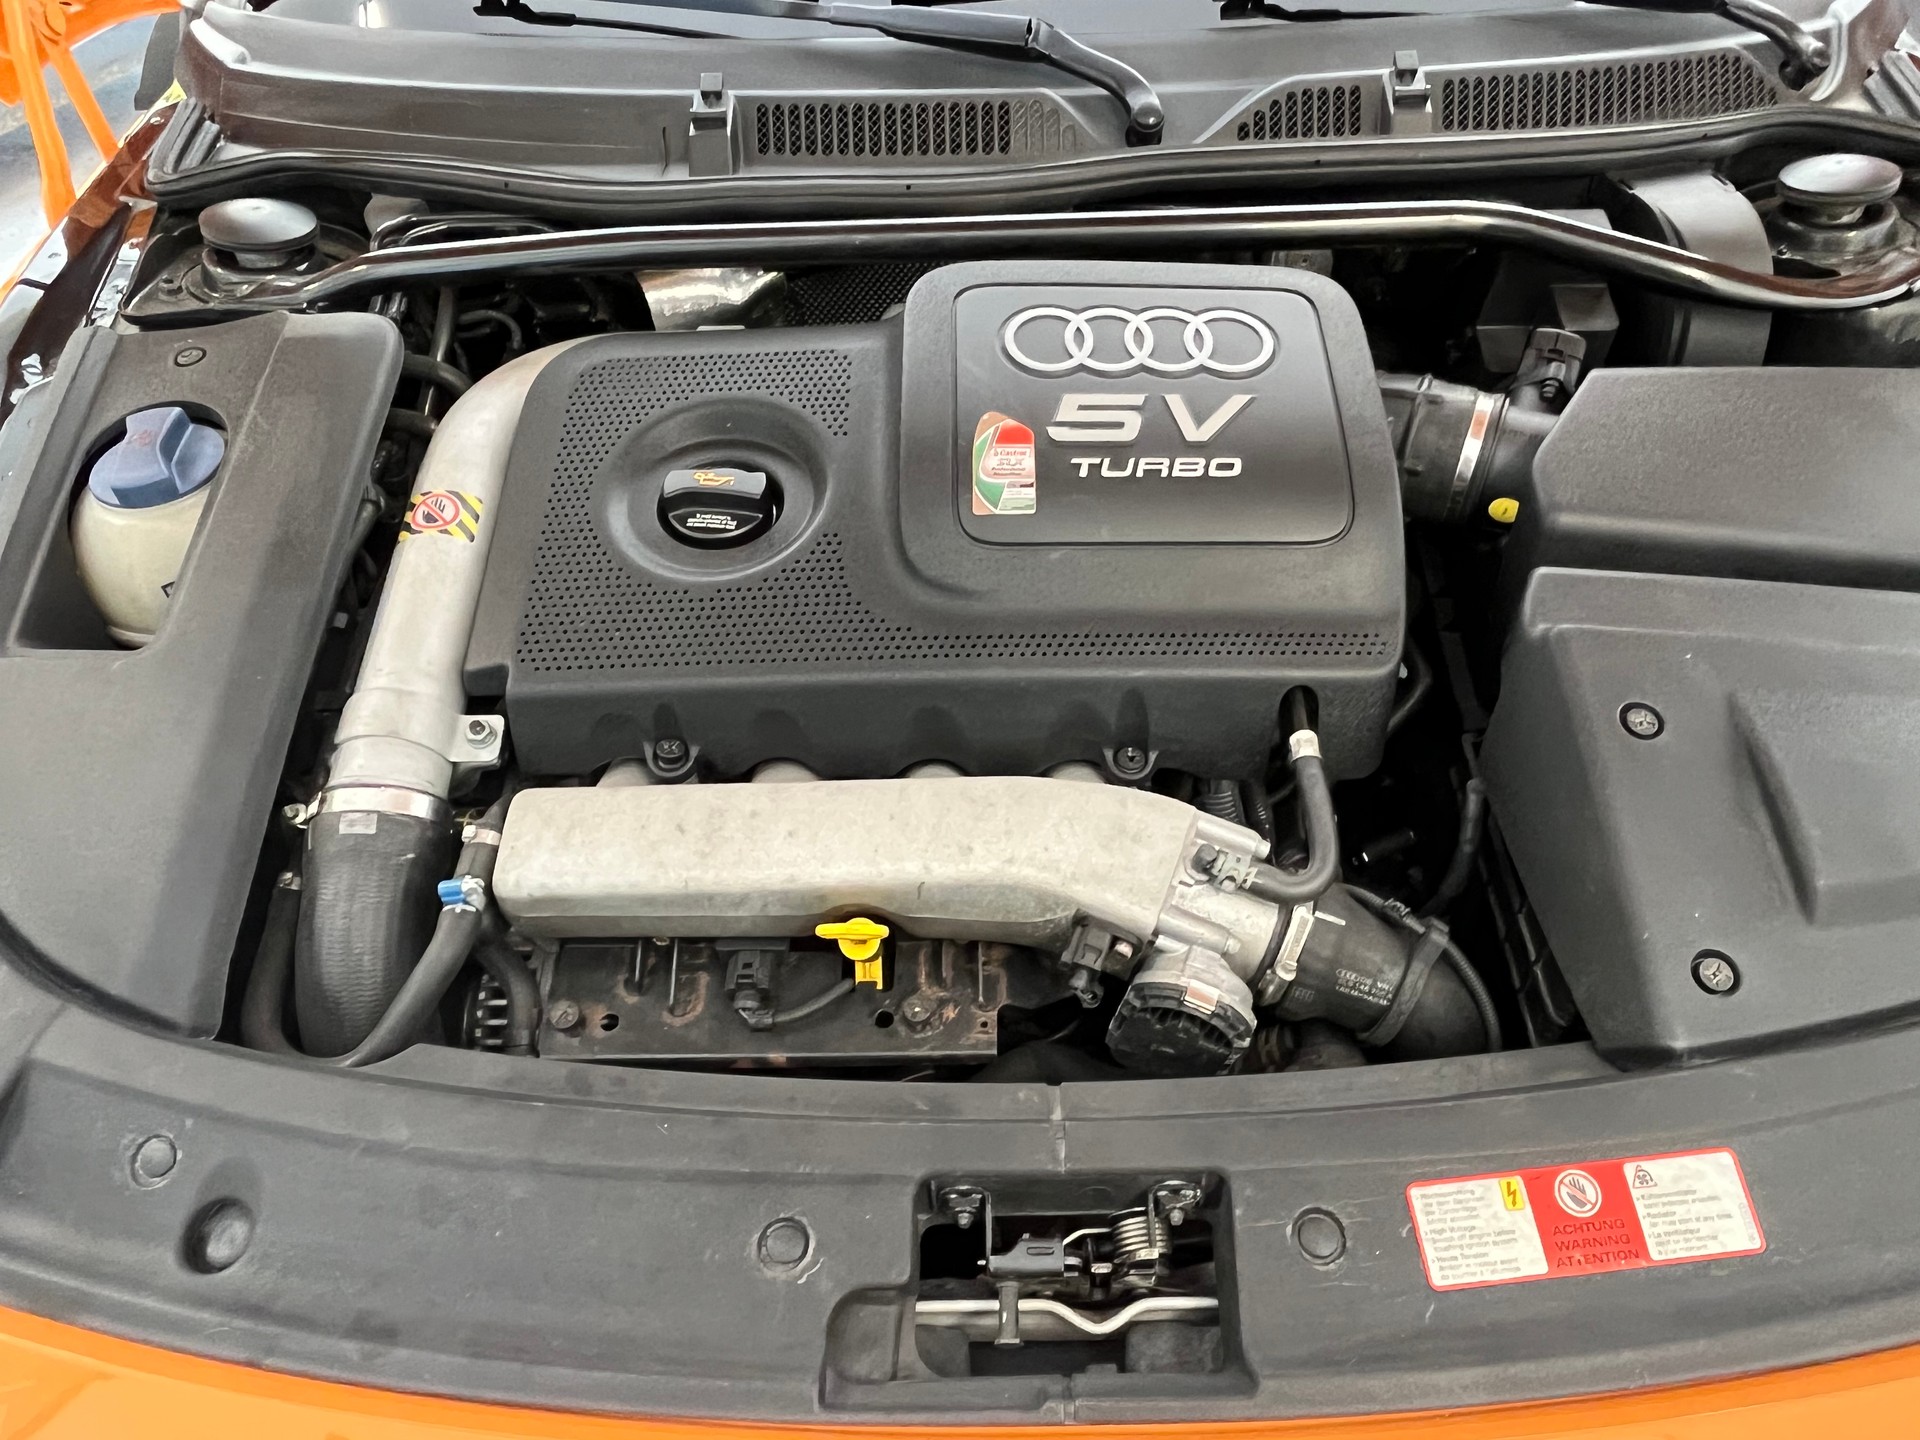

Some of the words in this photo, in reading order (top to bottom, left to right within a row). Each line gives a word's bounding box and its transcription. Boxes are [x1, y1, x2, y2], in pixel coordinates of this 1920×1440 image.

[1070, 457, 1242, 478] TURBO
[1553, 1218, 1625, 1236] ACHTUNG
[1554, 1234, 1631, 1252] WARNING
